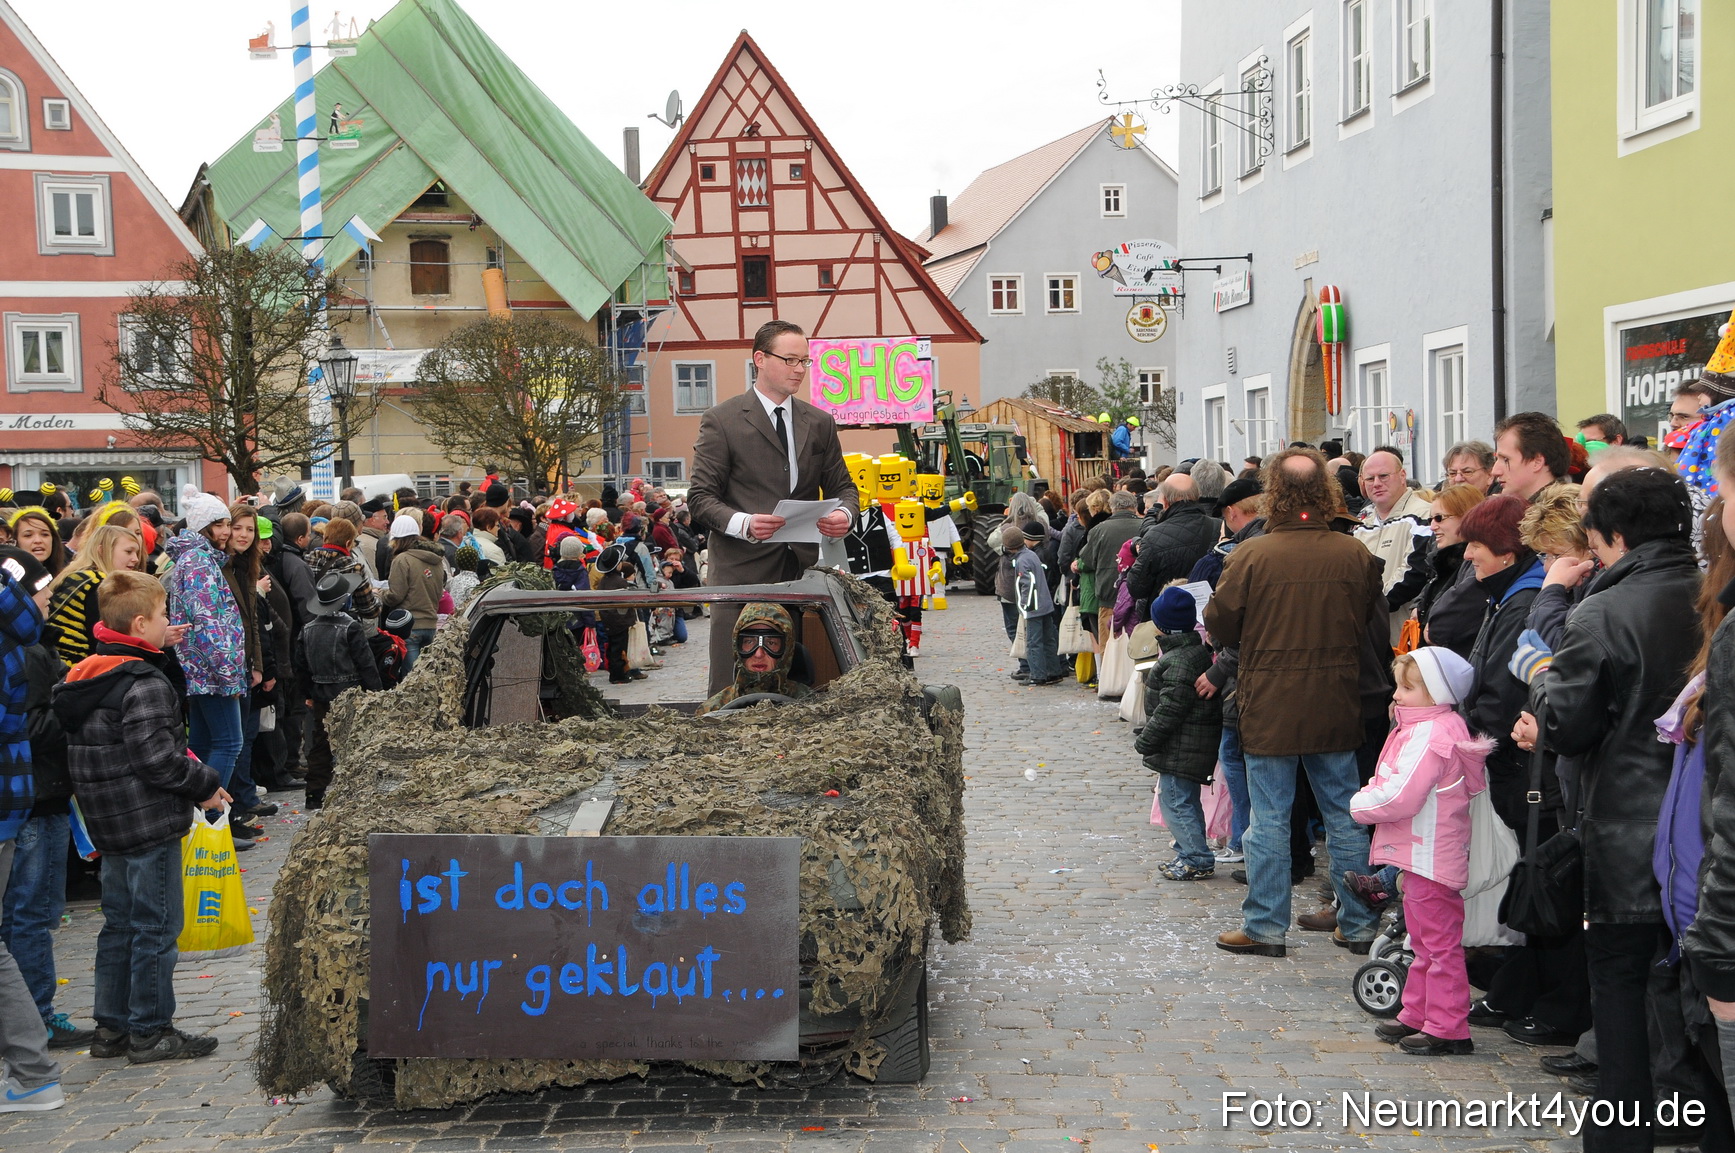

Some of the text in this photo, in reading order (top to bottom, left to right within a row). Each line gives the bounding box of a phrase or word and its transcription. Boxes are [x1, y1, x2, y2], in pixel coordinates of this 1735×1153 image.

[1127, 242, 1162, 250] Pizzeria
[1136, 253, 1155, 261] Café
[1127, 264, 1163, 273] Eisdile
[1626, 338, 1688, 361] FAHRSCHULE
[821, 343, 930, 405] SHG 37
[831, 407, 910, 422] Burggriesbach
[9, 415, 76, 429] Moden
[195, 847, 209, 860] Wir
[400, 858, 747, 920] ist doch alles
[197, 917, 220, 925] EDEKA
[422, 960, 503, 1003] nur
[595, 1036, 637, 1054] special
[646, 1036, 683, 1049] thanks
[689, 1036, 700, 1049] to
[707, 1036, 723, 1049] the
